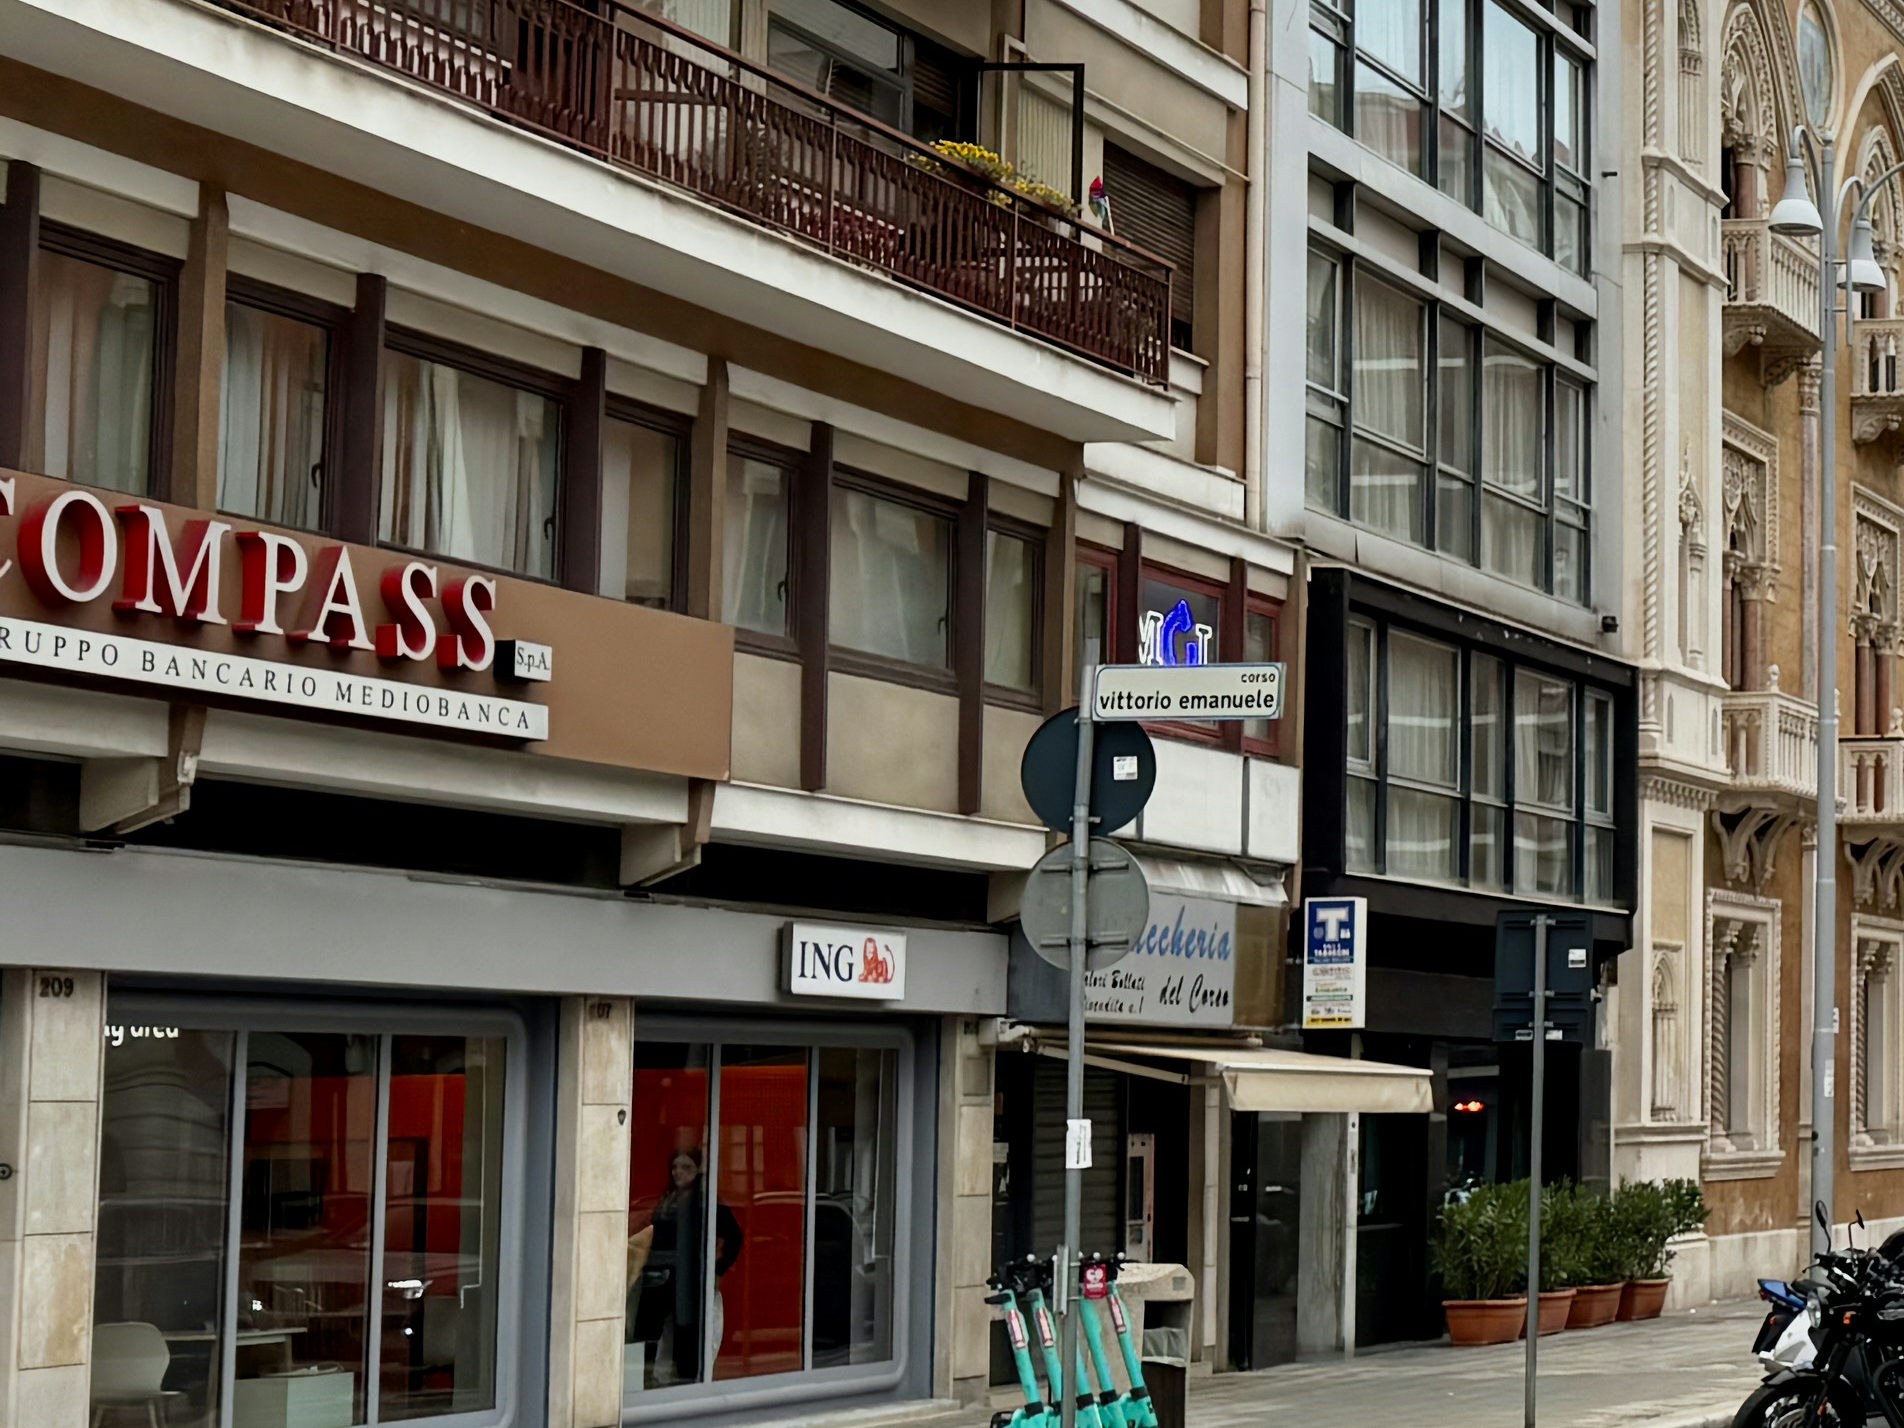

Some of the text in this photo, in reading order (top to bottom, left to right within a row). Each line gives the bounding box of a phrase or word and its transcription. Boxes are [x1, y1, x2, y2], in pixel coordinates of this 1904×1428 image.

[0, 477, 496, 672] OMPASS
[142, 649, 317, 697] BANCARIO
[335, 680, 530, 730] MEDIOBANCA
[1240, 672, 1276, 684] corso
[1100, 689, 1275, 710] vittorio emanuele
[1135, 904, 1232, 961] ccheria
[1316, 907, 1350, 942] T
[797, 940, 854, 983] ING
[38, 976, 75, 998] 209
[1159, 973, 1229, 1014] del Corso
